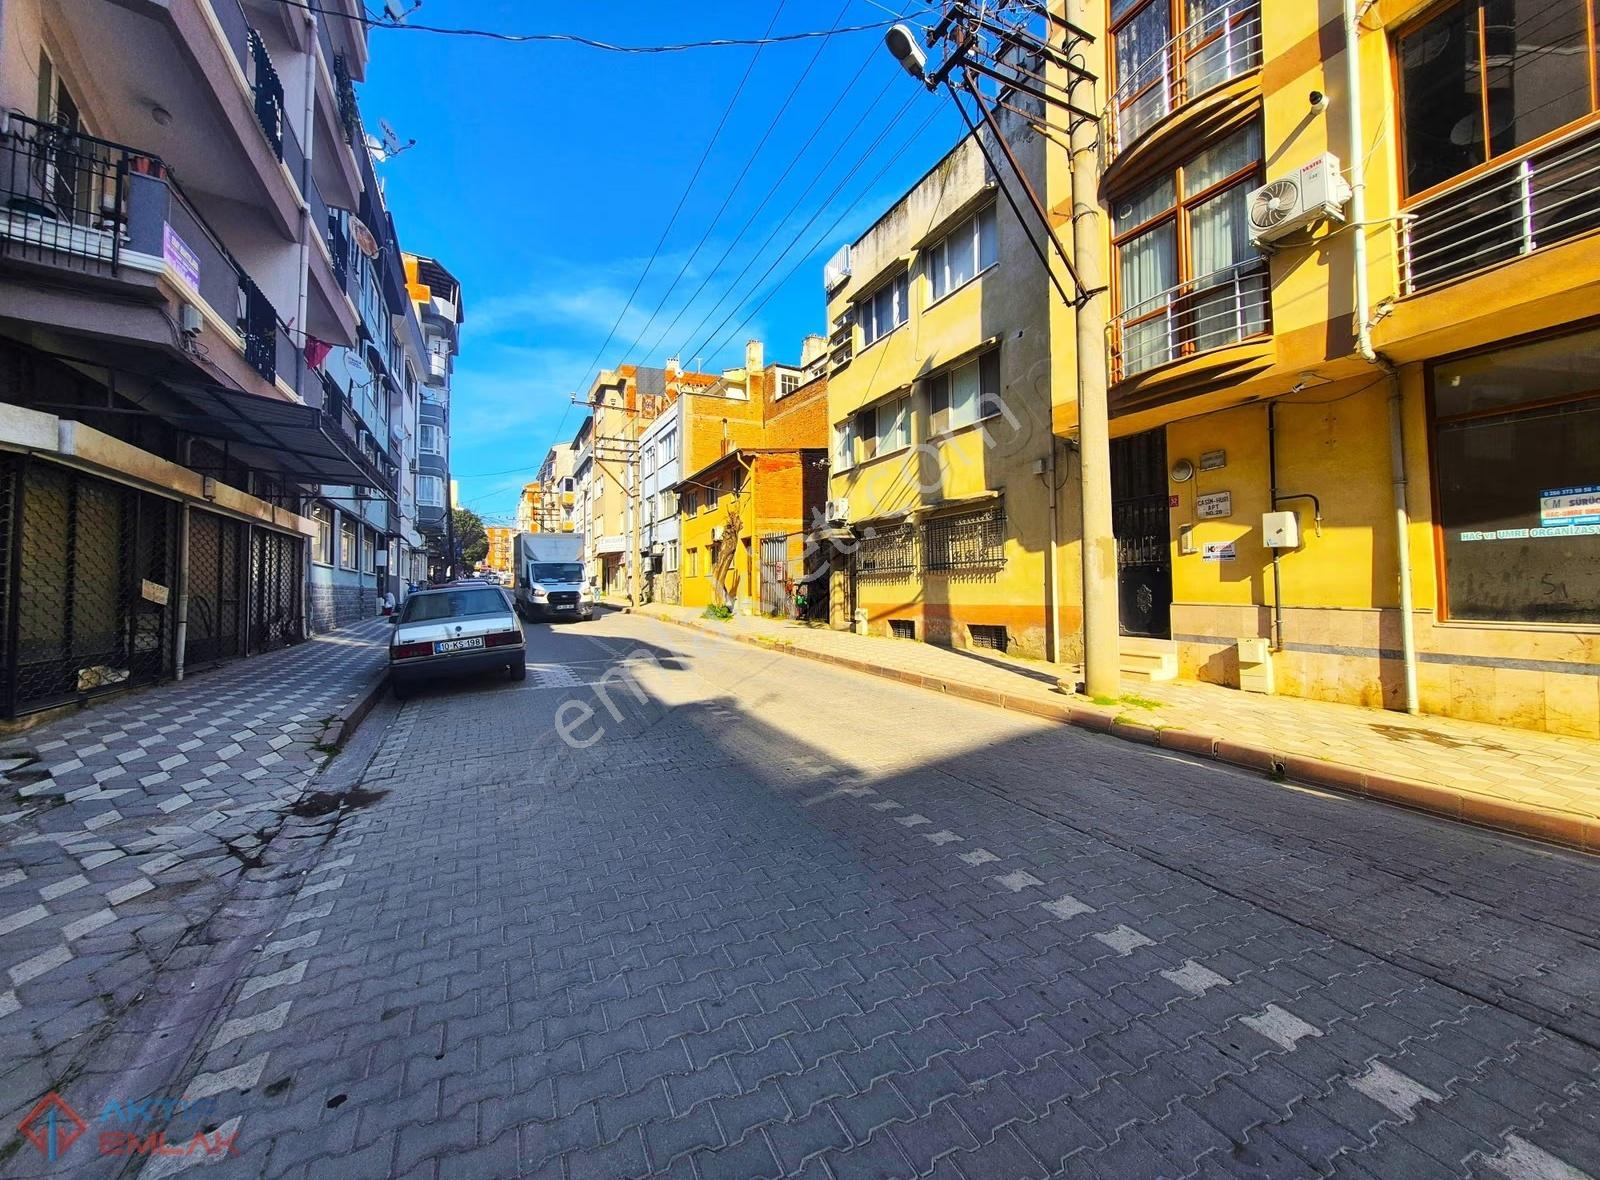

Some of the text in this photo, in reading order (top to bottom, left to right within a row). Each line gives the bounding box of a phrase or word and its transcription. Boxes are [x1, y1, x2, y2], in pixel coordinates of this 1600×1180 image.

[441, 638, 481, 651] 10 KS 198
